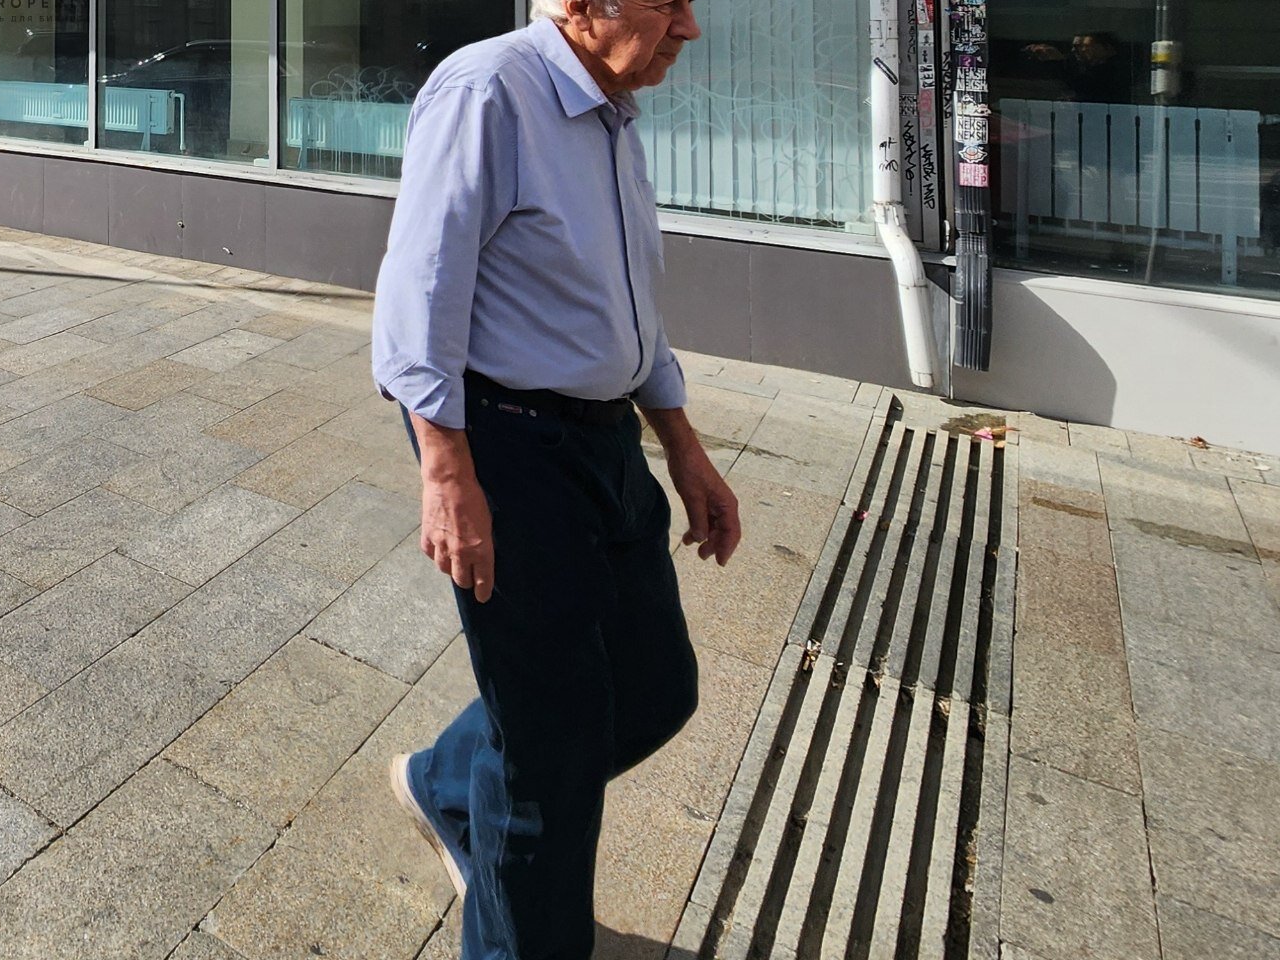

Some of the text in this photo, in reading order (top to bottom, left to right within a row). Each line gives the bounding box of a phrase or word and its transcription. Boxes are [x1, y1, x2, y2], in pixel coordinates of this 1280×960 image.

[956, 79, 987, 90] NEKSH
[958, 118, 987, 131] NEKSH
[958, 131, 987, 143] NEKSH
